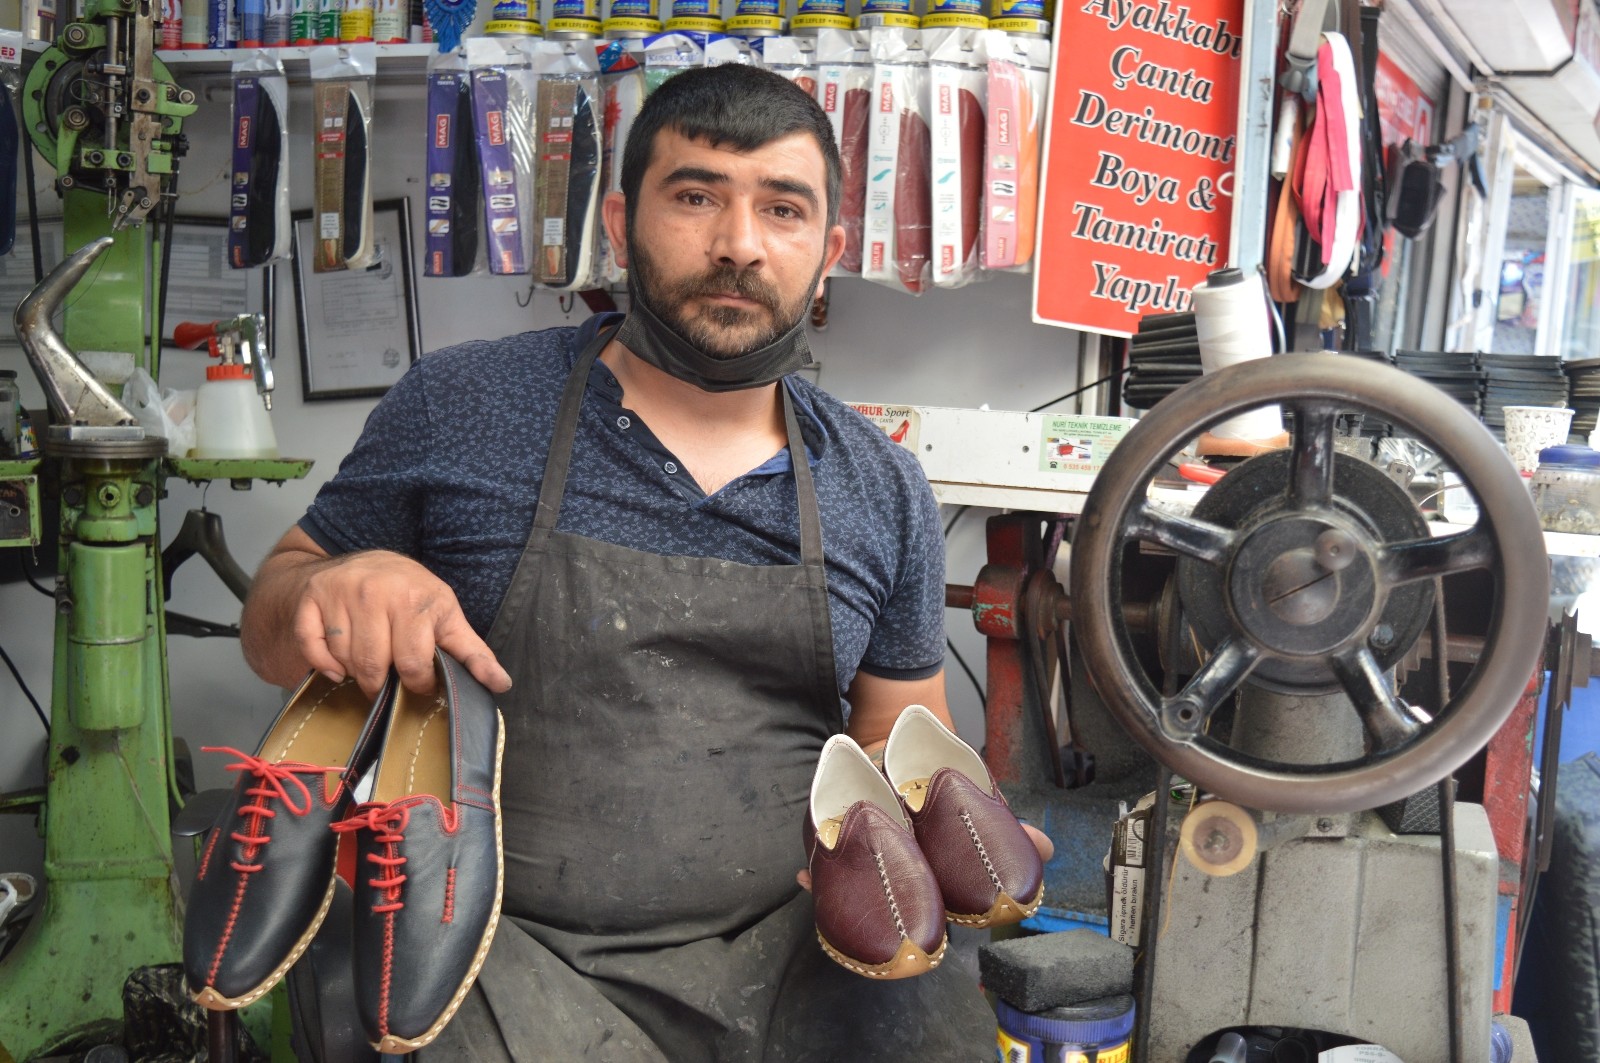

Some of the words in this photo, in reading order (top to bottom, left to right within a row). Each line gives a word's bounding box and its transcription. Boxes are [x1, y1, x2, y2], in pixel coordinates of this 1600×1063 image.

[1111, 46, 1213, 103] Çanta
[827, 85, 836, 111] MAG
[883, 85, 892, 111] MAG
[942, 86, 950, 113] MAG
[240, 120, 249, 146] MAG
[439, 118, 448, 145] MAG
[491, 115, 502, 143] MAG
[999, 113, 1009, 144] MAG
[1072, 90, 1235, 163] Derimont
[1092, 151, 1179, 205] Boya
[1188, 176, 1217, 212] &
[1072, 203, 1218, 265] Tamiratı
[885, 407, 911, 418] Sport
[1068, 422, 1088, 430] TEKNİK
[1130, 879, 1138, 904] bırakın
[1129, 905, 1137, 930] hemen
